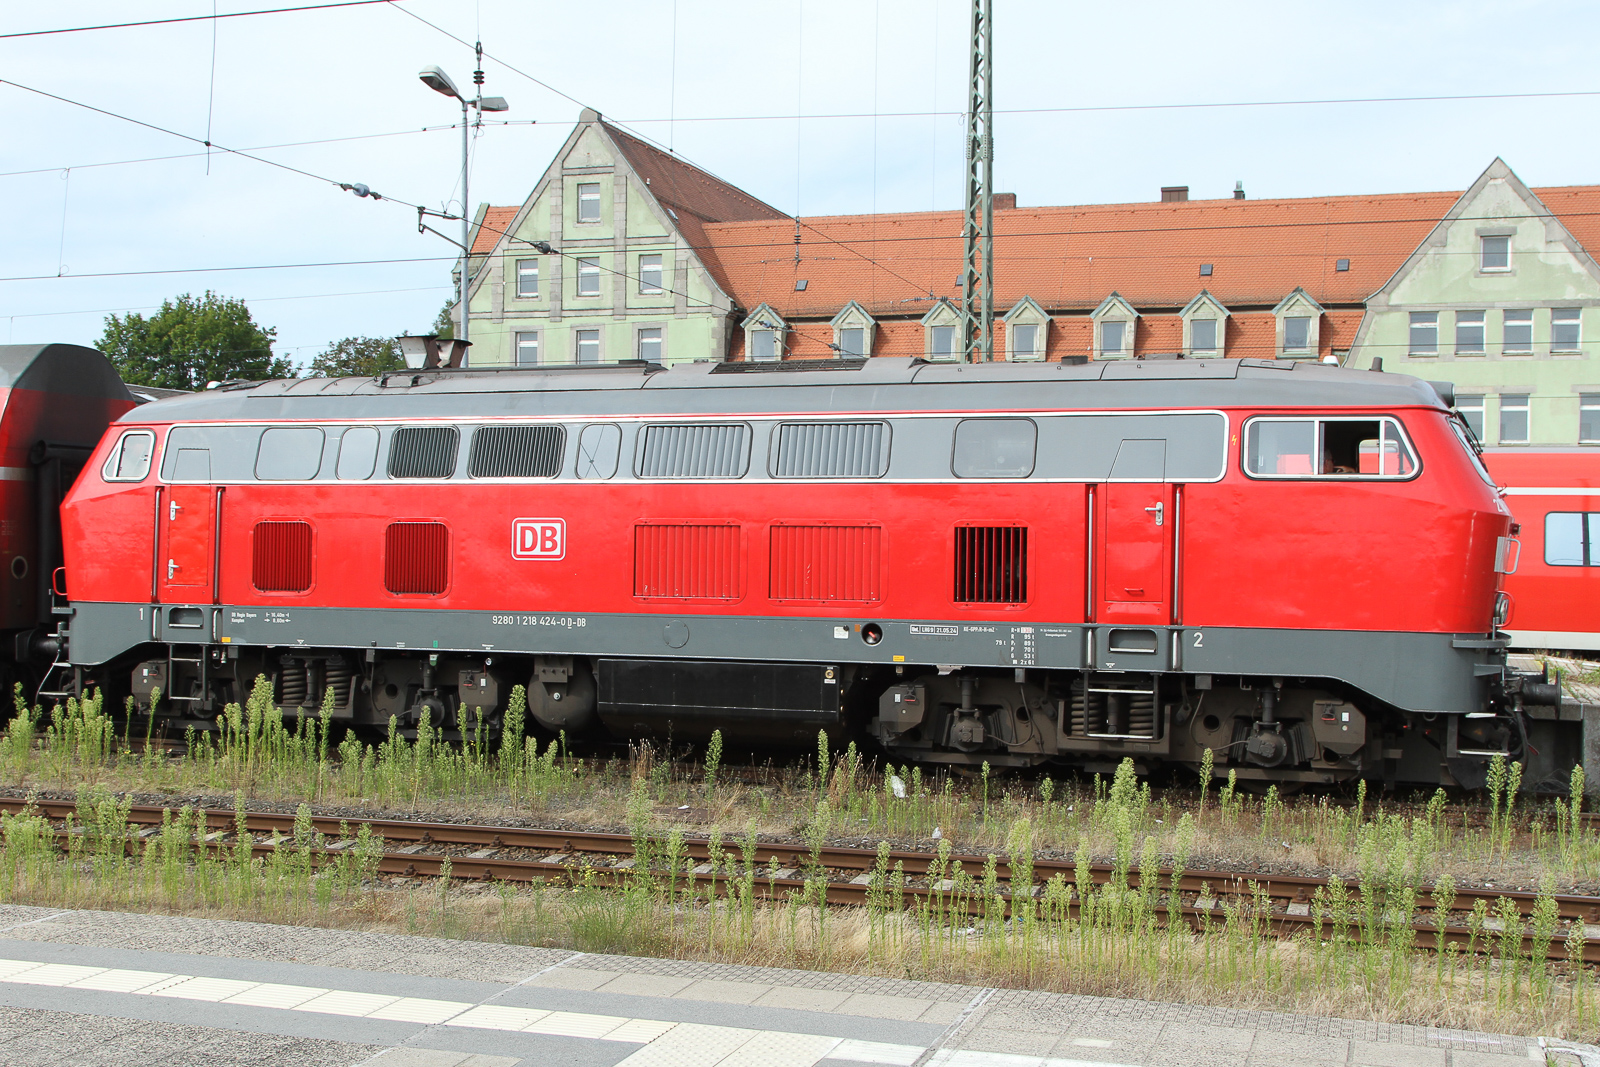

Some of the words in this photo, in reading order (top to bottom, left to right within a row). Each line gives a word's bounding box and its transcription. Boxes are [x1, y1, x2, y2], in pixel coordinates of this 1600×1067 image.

[520, 526, 558, 552] DB
[139, 608, 144, 620] 1
[492, 616, 514, 625] 9280
[516, 616, 520, 625] 1
[523, 616, 537, 625] 218
[540, 617, 566, 626] 424-0
[567, 618, 586, 629] D-DB
[1194, 632, 1203, 647] 2
